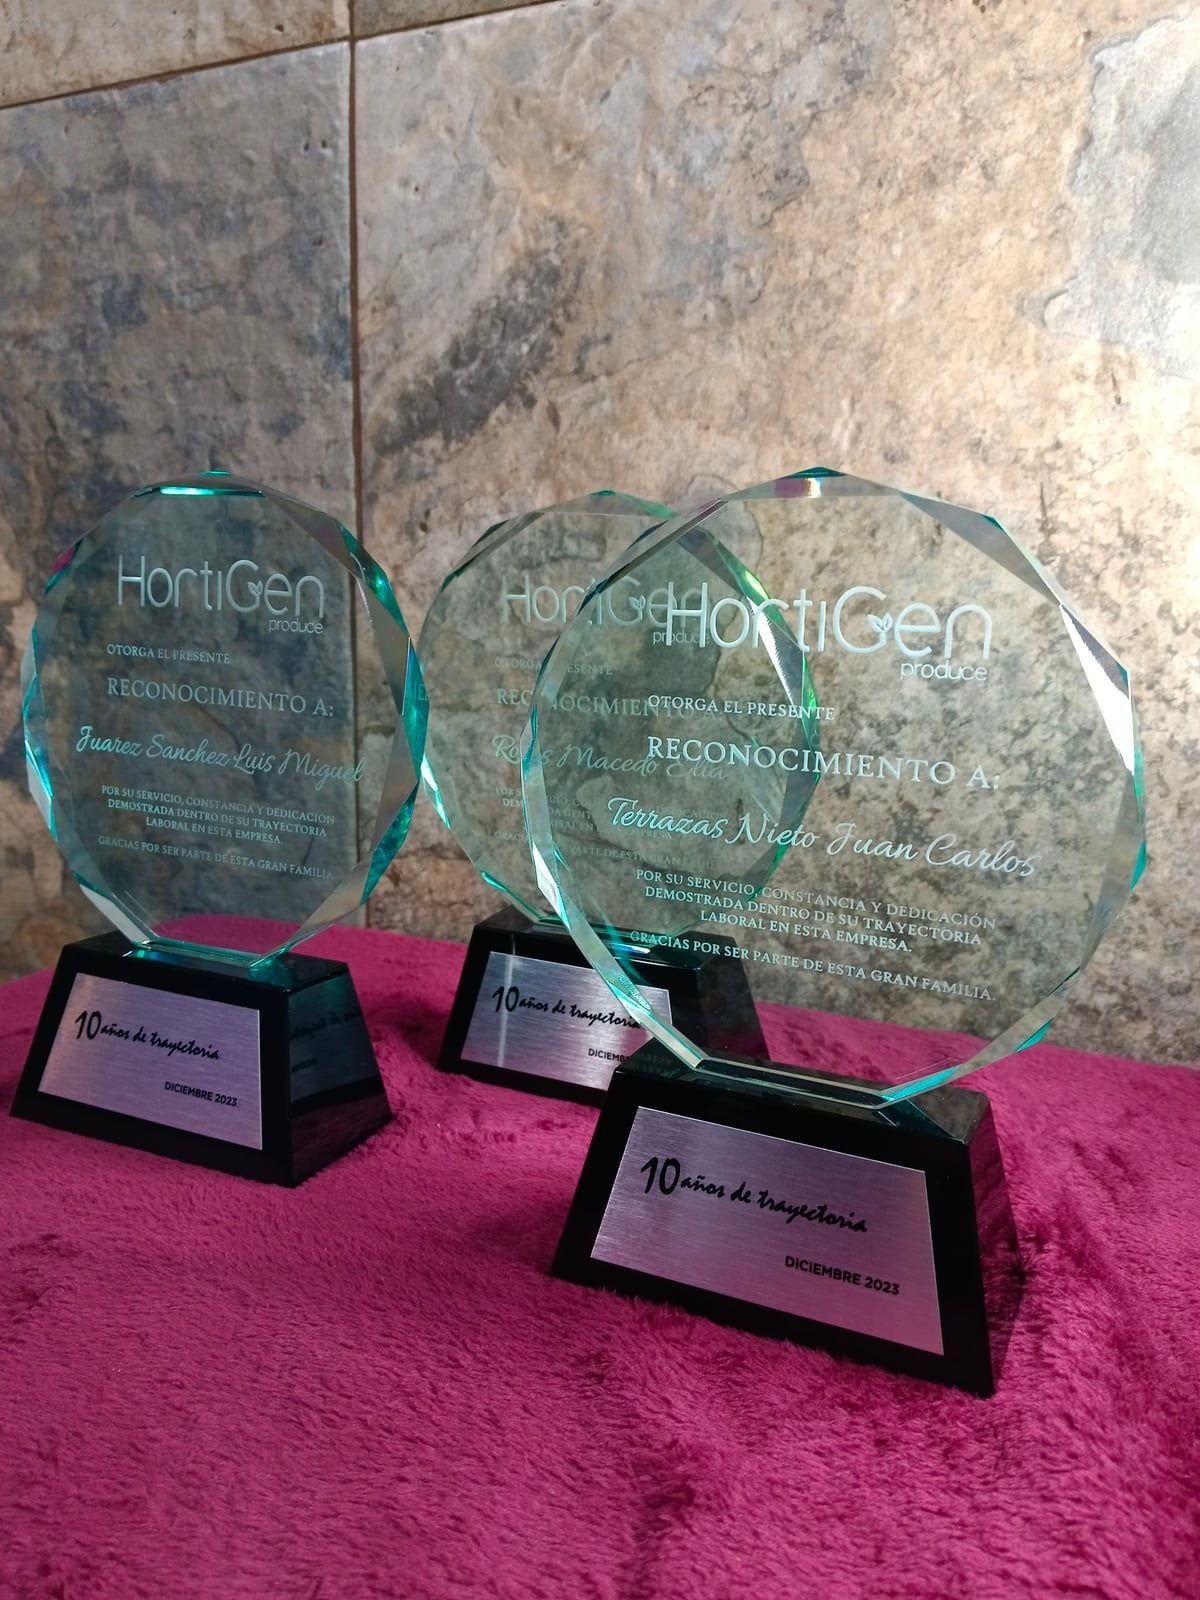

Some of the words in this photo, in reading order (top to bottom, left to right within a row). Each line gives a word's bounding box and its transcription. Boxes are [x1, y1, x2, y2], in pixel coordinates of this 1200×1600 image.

[118, 555, 324, 618] HortiGen
[502, 573, 706, 629] HoriGen
[268, 617, 323, 634] produce
[666, 581, 993, 660] HortiGen
[107, 643, 154, 658] OTORGA
[157, 648, 170, 660] EL
[172, 650, 230, 664] PRESENTE
[900, 659, 988, 682] produce
[107, 678, 306, 714] RECONOCIMIENTO
[312, 698, 334, 717] A:
[648, 694, 718, 713] OTORGA
[723, 699, 743, 715] EL
[747, 702, 836, 721] PRESENTE
[76, 726, 142, 757] Juarez
[146, 734, 230, 767] Sanchez
[233, 743, 275, 774] Luis
[278, 749, 368, 791] Miguel
[556, 743, 658, 778] Macedo
[647, 736, 957, 785] RECONOCIMIENTO
[966, 763, 1000, 790] A:
[101, 785, 121, 797] POR
[122, 787, 135, 798] SU
[186, 796, 254, 814] CONSTANCIA
[256, 804, 265, 815] Y
[108, 798, 175, 816] DEMOSTRADA
[177, 808, 219, 823] DENTRO
[221, 814, 235, 825] DE
[237, 815, 250, 826] SU
[252, 818, 327, 837] TRAYECTORIA
[146, 816, 190, 832] LABORAL
[192, 823, 206, 833] EN
[208, 825, 233, 837] ESTA
[235, 829, 283, 845] EMPRESA.
[607, 797, 729, 840] Terrazas
[725, 812, 820, 849] Nieto
[826, 821, 918, 862] Juan
[925, 832, 1041, 877] Carlos
[98, 835, 139, 850] GRACIAS
[141, 842, 160, 853] POR
[162, 844, 179, 856] SER
[181, 848, 212, 861] PARTE
[214, 852, 228, 864] DE
[230, 855, 255, 868] ESTA
[257, 859, 287, 873] GRAN
[636, 869, 662, 882] POR
[665, 872, 683, 885] SU
[687, 875, 758, 898] SERVICIO,
[761, 886, 867, 912] CONSTANCIA
[871, 901, 883, 914] Y
[886, 903, 997, 930] DEDICACIÓN
[645, 886, 744, 911] DEMOSTRADA
[747, 899, 810, 920] DENTRO
[813, 908, 834, 923] DE
[838, 911, 859, 926] SU
[863, 915, 982, 945] TRAYECTORIA
[700, 909, 767, 930] LABORAL
[769, 919, 790, 933] EN
[793, 923, 832, 940] ESTA
[836, 930, 913, 953] EMPRESA.
[629, 930, 690, 951] GRACIAS
[693, 940, 721, 955] POR
[723, 944, 750, 960] SER
[753, 950, 799, 968] PARTE
[802, 957, 823, 972] DE
[827, 962, 866, 980] ESTA
[870, 969, 918, 988] GRAN
[921, 977, 996, 1001] FAMILIA.
[492, 985, 520, 1013] 10
[518, 997, 549, 1012] años
[551, 1000, 566, 1015] de
[75, 1010, 101, 1040] 10
[100, 1023, 130, 1041] años
[132, 1025, 147, 1043] de
[149, 1031, 220, 1061] trayectoria
[588, 1047, 630, 1063] DICIEMB
[164, 1080, 213, 1102] DICIEMBRE
[214, 1093, 238, 1108] 2023
[640, 1157, 681, 1195] 10
[680, 1174, 725, 1198] años
[730, 1181, 752, 1204] de
[757, 1190, 868, 1233] trayectoria
[785, 1255, 861, 1285] DICIEMBRE
[864, 1275, 900, 1296] 2023
